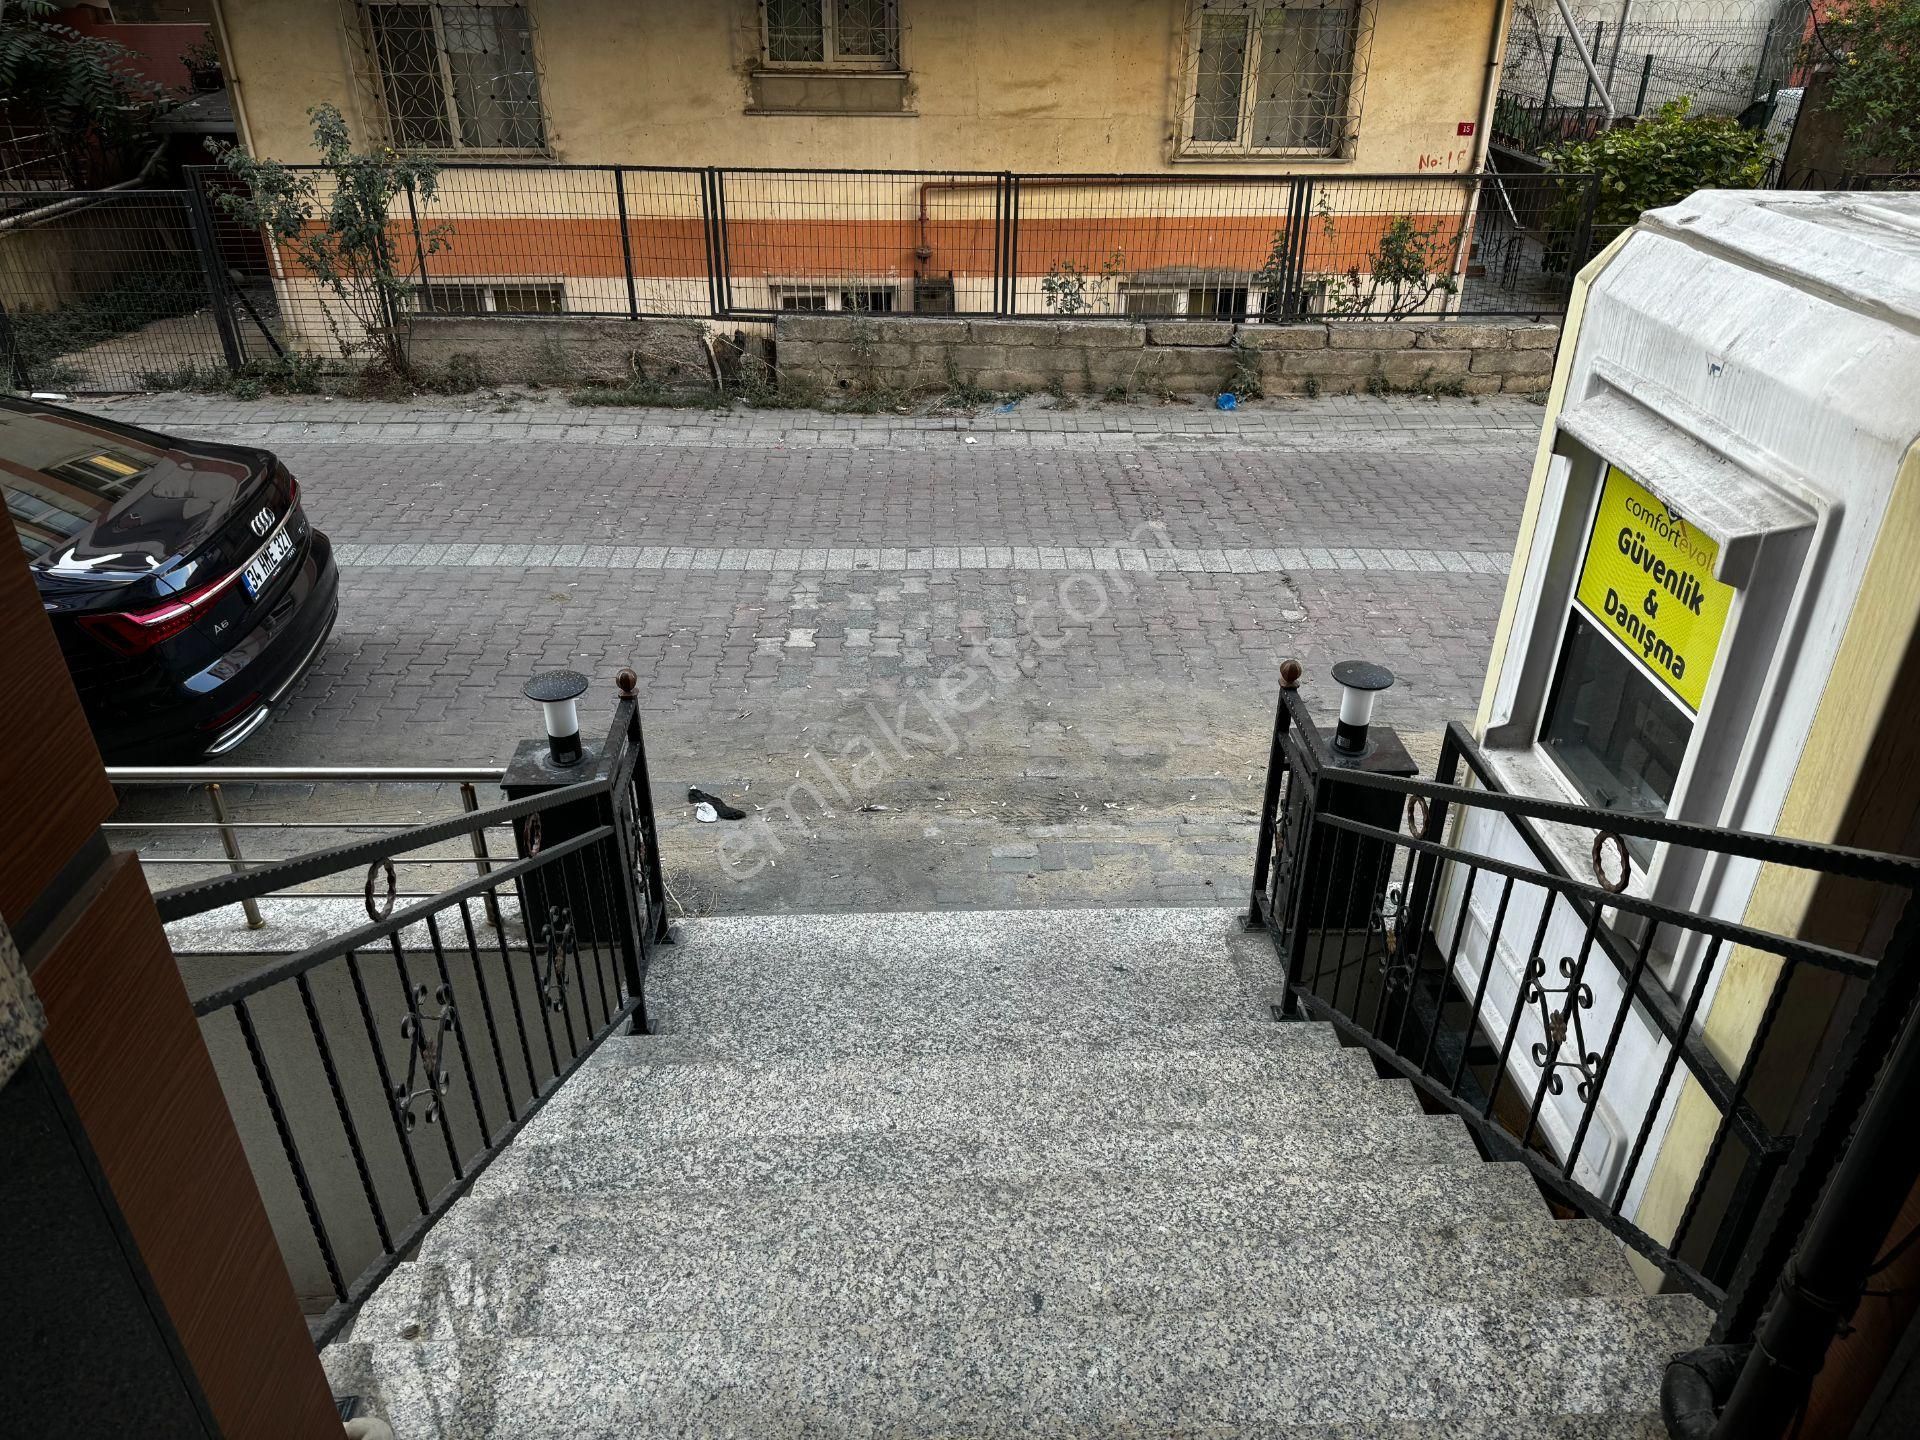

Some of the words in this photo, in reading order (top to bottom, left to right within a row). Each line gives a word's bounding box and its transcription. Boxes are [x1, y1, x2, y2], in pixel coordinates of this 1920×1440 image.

[246, 565, 263, 590] 34
[257, 546, 279, 576] HME
[273, 527, 292, 556] 321
[1618, 526, 1705, 617] Güvenlik
[214, 619, 229, 636] A6
[1603, 587, 1686, 681] Danışma
[1643, 589, 1659, 620] &
